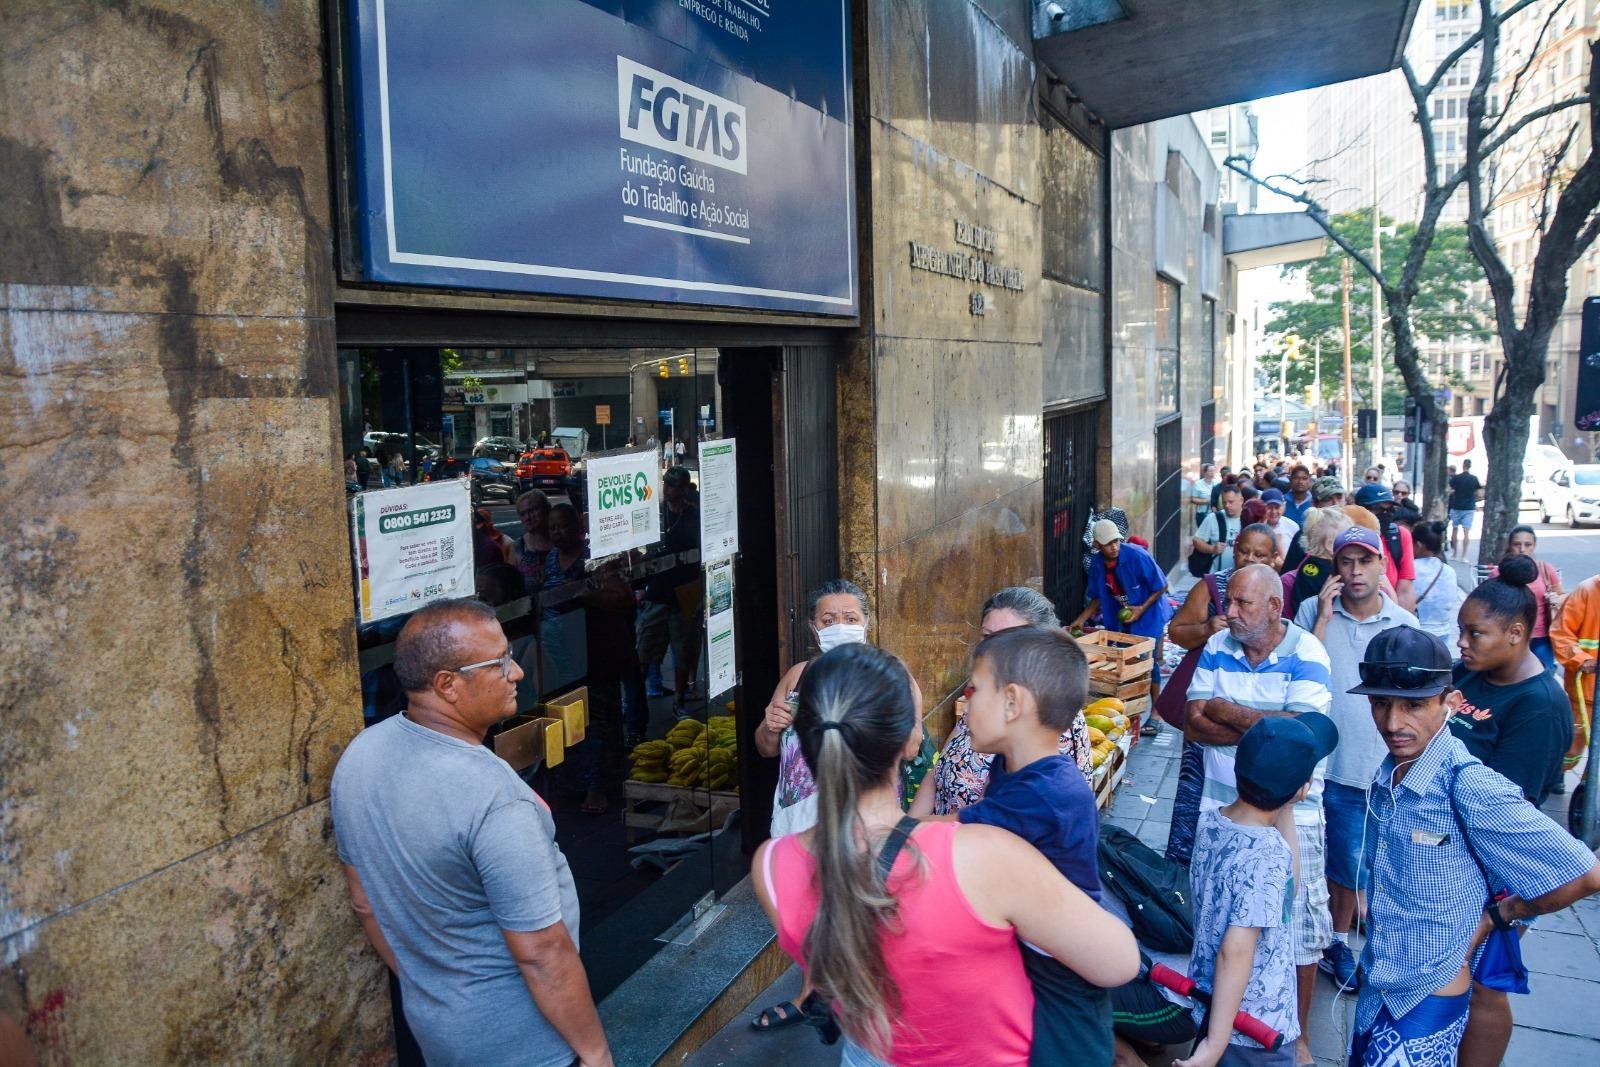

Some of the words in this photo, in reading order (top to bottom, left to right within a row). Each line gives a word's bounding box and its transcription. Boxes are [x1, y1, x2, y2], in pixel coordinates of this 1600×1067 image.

[679, 0, 717, 24] EMPREGO
[719, 14, 724, 28] E
[725, 18, 749, 43] RENDA
[627, 74, 741, 160] FGTAS
[620, 147, 676, 186] Fundação
[679, 164, 715, 193] Gaúcha
[622, 181, 639, 206] do
[641, 185, 689, 217] Trabalho
[691, 202, 698, 219] e
[700, 199, 722, 227] Ação
[724, 205, 750, 229] Social
[598, 474, 632, 489] DEVOLVE
[598, 485, 633, 510] ICMS
[380, 504, 408, 514] DÚVIDAS:
[384, 515, 411, 530] 0800
[413, 511, 429, 525] 541
[431, 508, 451, 522] 2323
